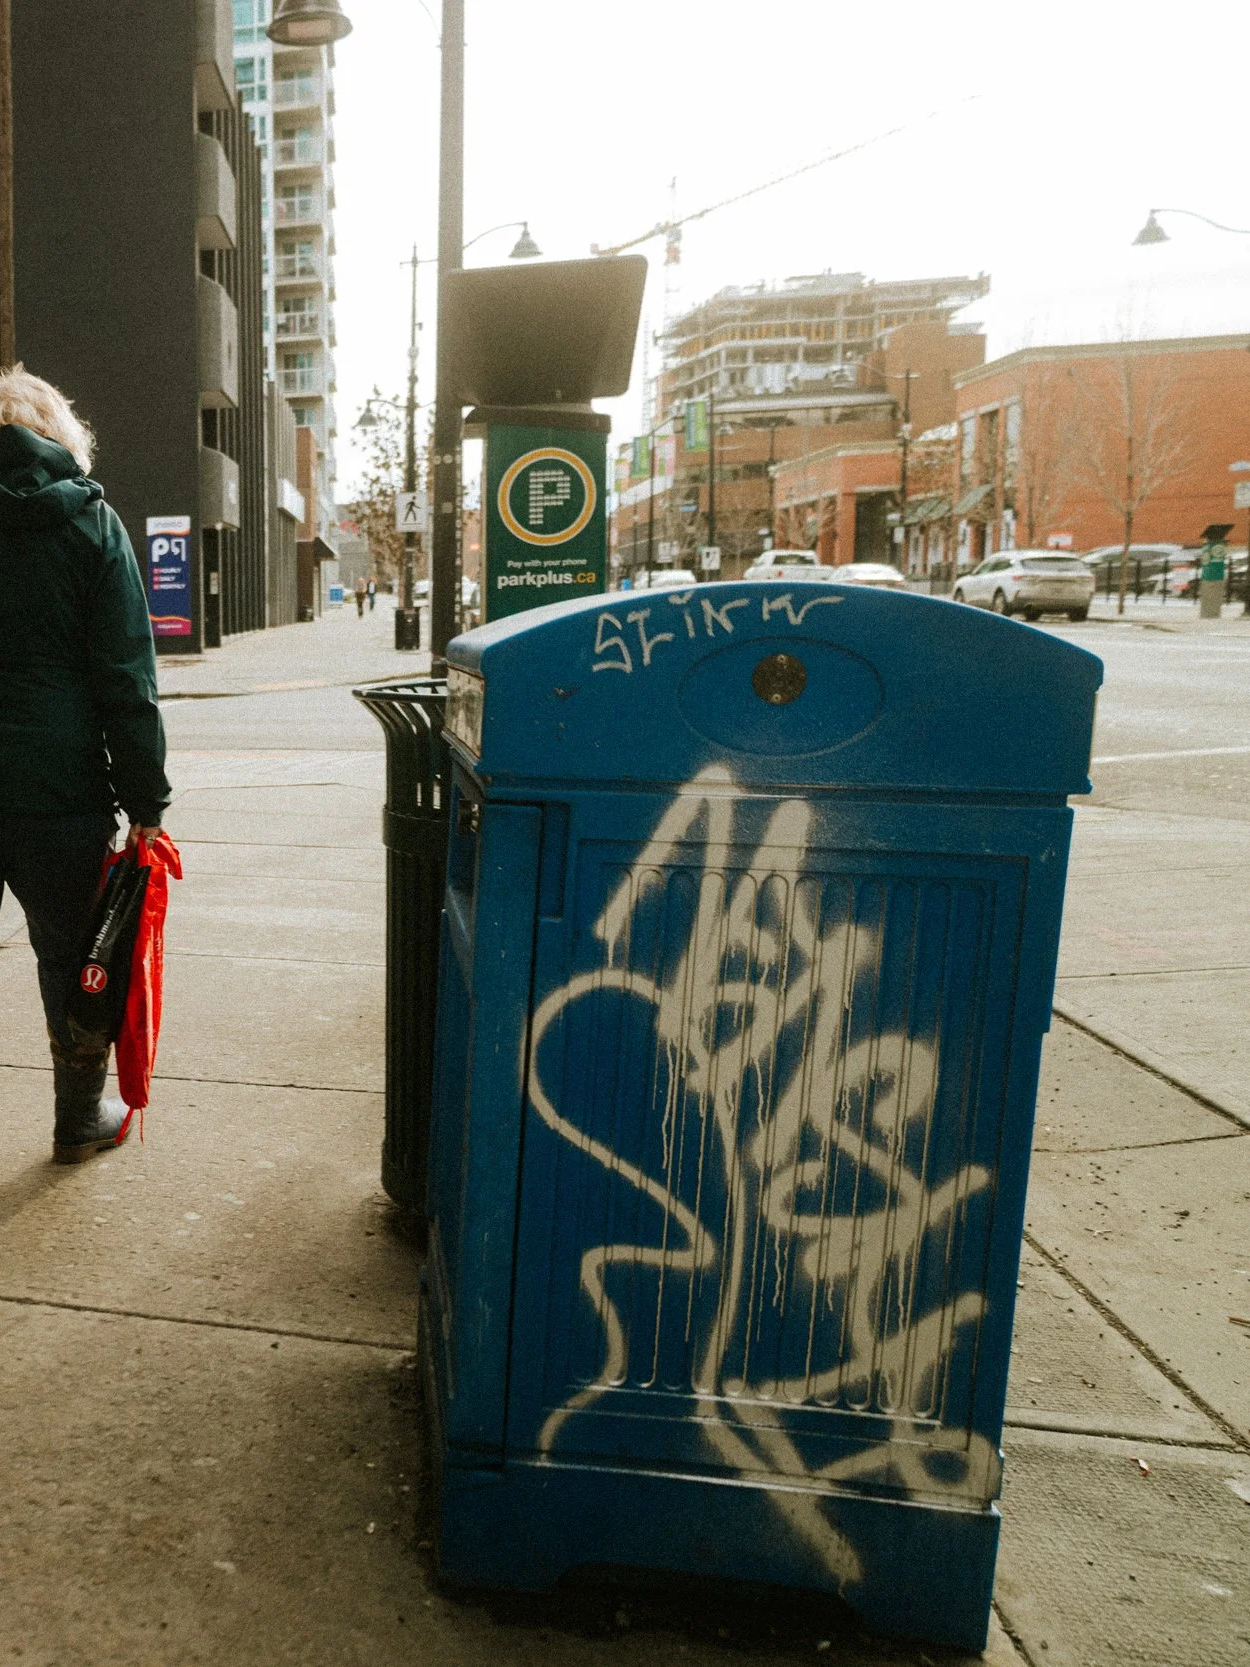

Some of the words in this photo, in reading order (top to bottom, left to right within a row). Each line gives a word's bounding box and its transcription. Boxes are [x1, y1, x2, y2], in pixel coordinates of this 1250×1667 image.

[529, 470, 570, 525] P
[507, 560, 522, 569] Pay
[524, 559, 542, 567] with
[543, 559, 561, 567] your
[562, 558, 588, 566] phone
[497, 570, 596, 589] parkplus.ca
